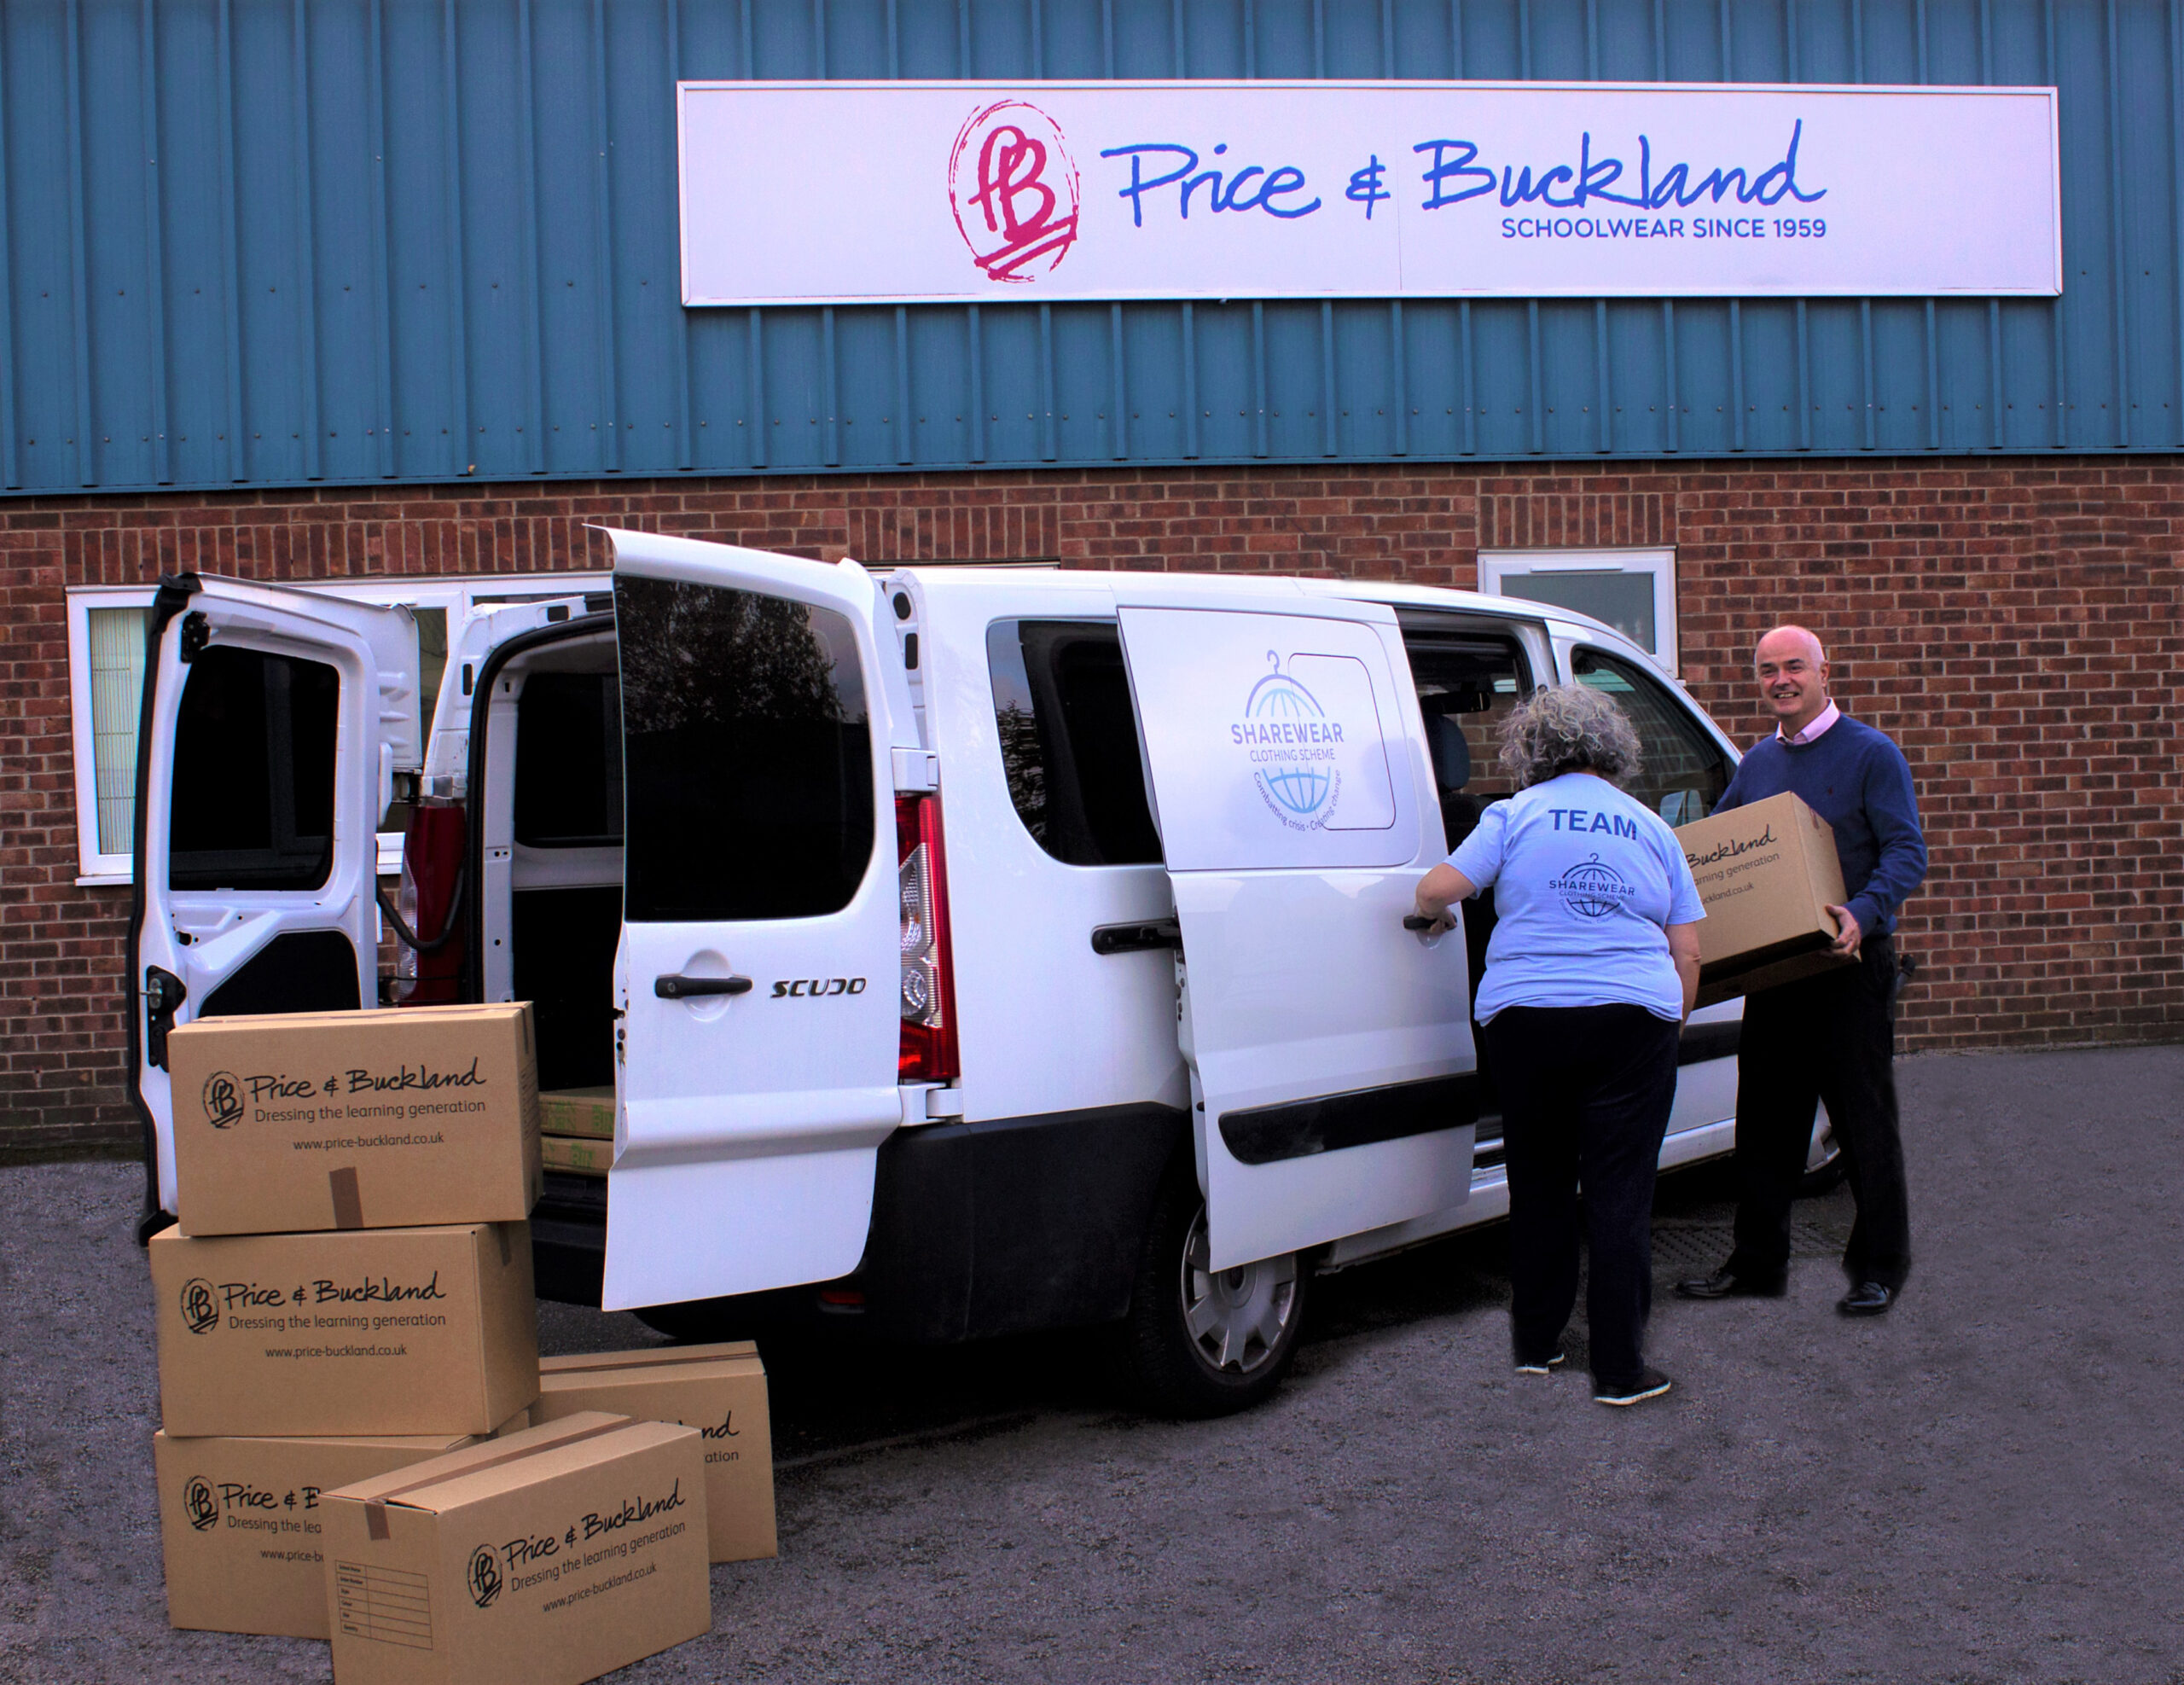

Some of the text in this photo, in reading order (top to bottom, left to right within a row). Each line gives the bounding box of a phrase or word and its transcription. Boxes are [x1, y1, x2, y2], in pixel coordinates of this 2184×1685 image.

[1101, 118, 1827, 227] Price & Buckland
[1502, 218, 1827, 237] SCHOOLWEAR SINCE 1959
[1231, 723, 1344, 744] SHAREWEAR
[1250, 748, 1336, 763] CLOTHING SCHEME
[1254, 772, 1287, 827] Combatting
[1289, 820, 1306, 832] crisis
[1332, 770, 1342, 807] change
[1548, 809, 1637, 840] TEAM
[1686, 823, 1777, 869] Buckland
[1694, 852, 1780, 886] arning generation
[1549, 880, 1635, 896] SHAREWEAR
[771, 978, 867, 998] SCUDO
[244, 1057, 486, 1103] Price & Buckland
[254, 1100, 486, 1124] Dressing the learning generation
[293, 1131, 444, 1151] www.price-buckland.co.uk
[218, 1270, 446, 1310] Price & Buckland
[229, 1314, 446, 1332] Dressing the learning generation
[265, 1345, 407, 1359] www.price-buckland.co.uk
[217, 1483, 279, 1509] Price
[283, 1490, 298, 1511] &
[228, 1515, 278, 1534] Dressing
[281, 1518, 301, 1531] the
[501, 1477, 686, 1571] Price & Buckland
[511, 1521, 686, 1593] Dressing the learning generation
[543, 1563, 657, 1612] www.price-buckland.co.uk
